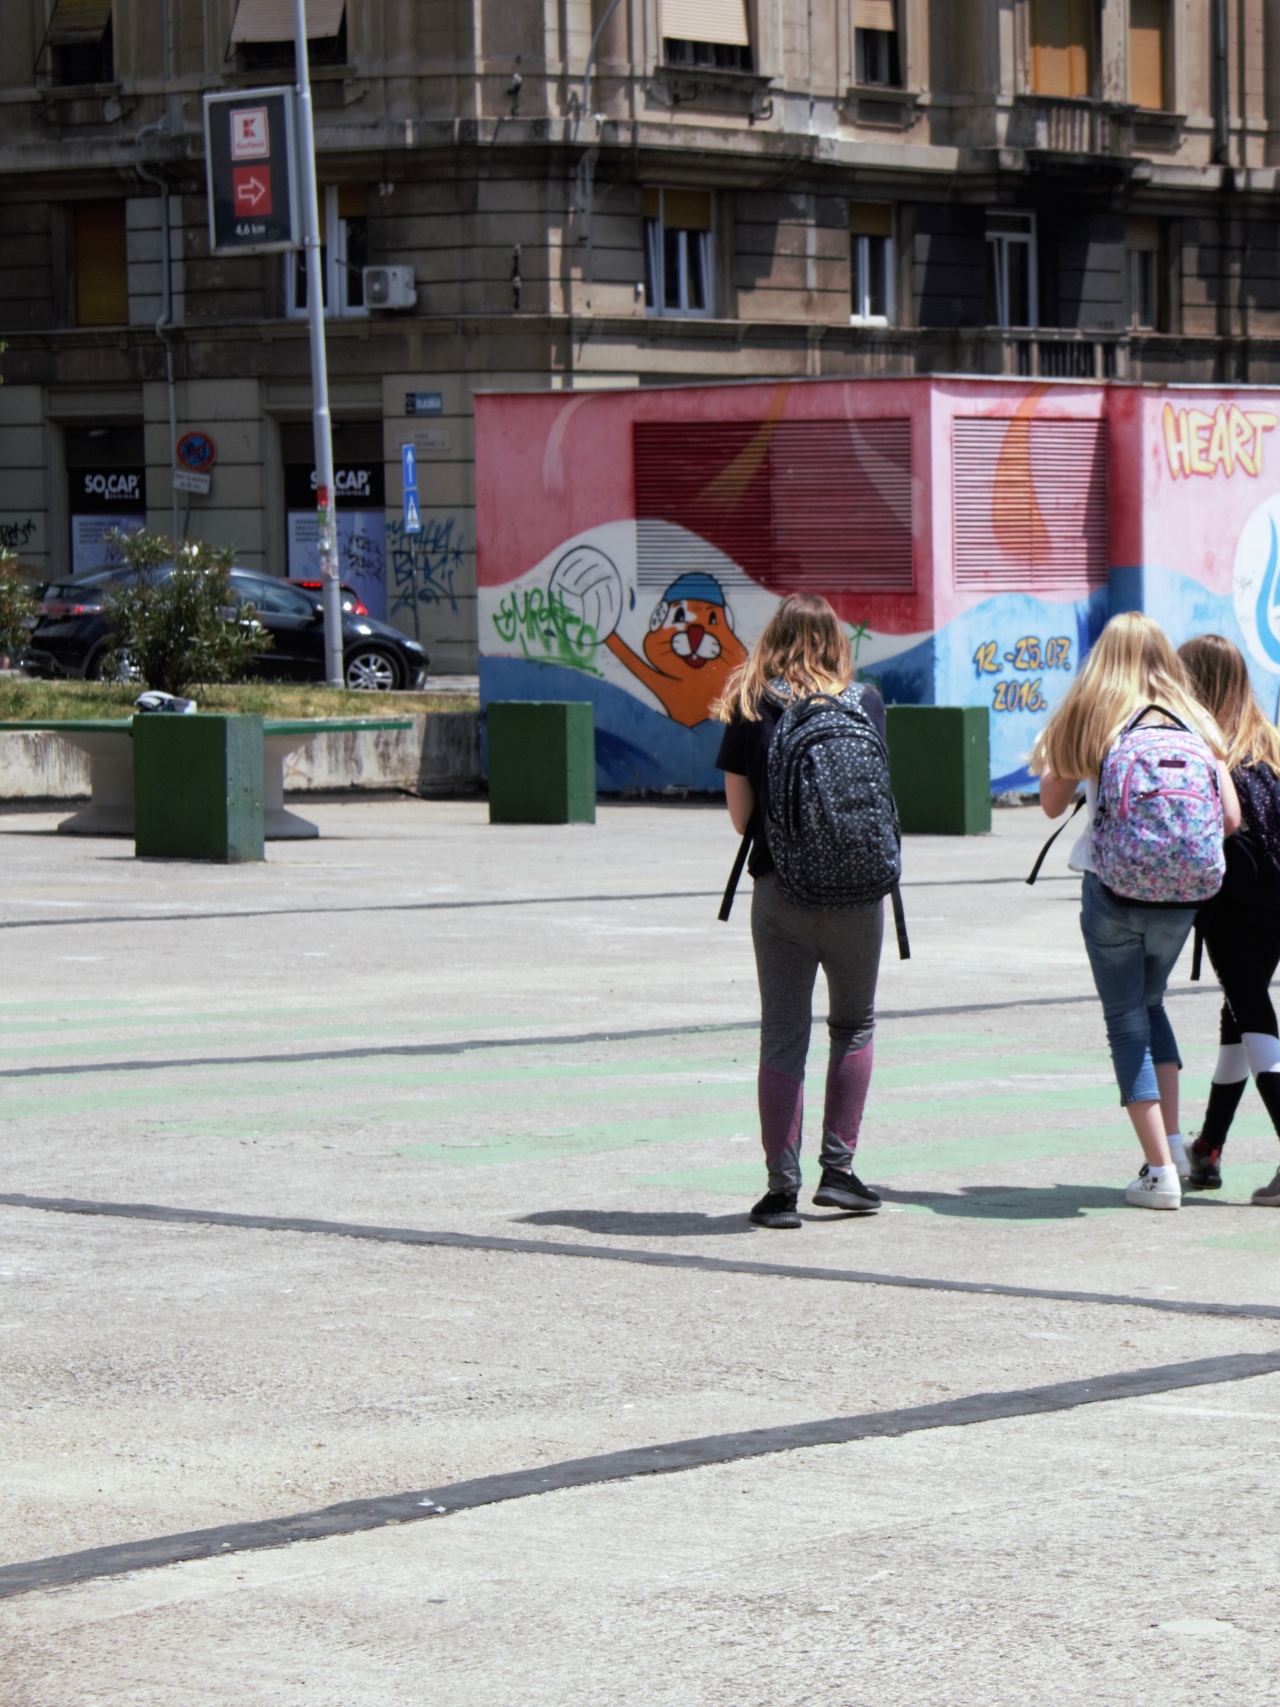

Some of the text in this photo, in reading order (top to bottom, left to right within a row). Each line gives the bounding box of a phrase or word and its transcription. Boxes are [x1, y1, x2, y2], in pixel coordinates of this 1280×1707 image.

[235, 222, 266, 237] 4,6 km
[1163, 402, 1280, 481] HEART
[993, 678, 1047, 712] 2016.
